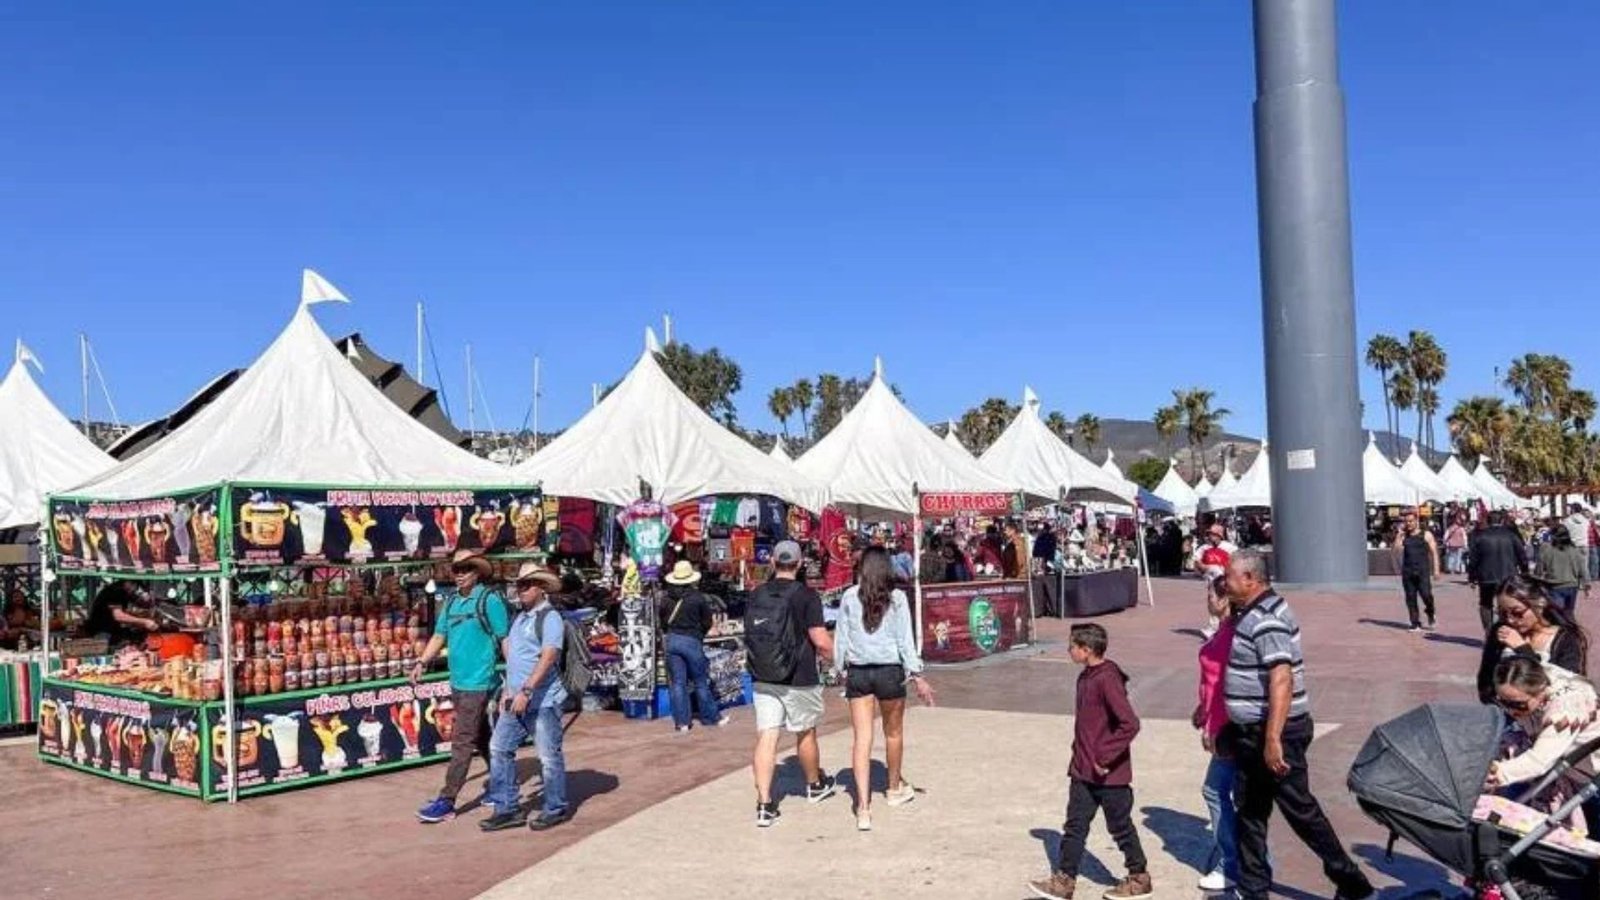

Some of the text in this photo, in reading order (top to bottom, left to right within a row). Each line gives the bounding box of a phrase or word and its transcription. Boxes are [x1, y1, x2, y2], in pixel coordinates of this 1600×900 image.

[922, 493, 1007, 511] CHURROS
[305, 694, 350, 715] PIÑAS
[351, 686, 414, 708] COLADAS
